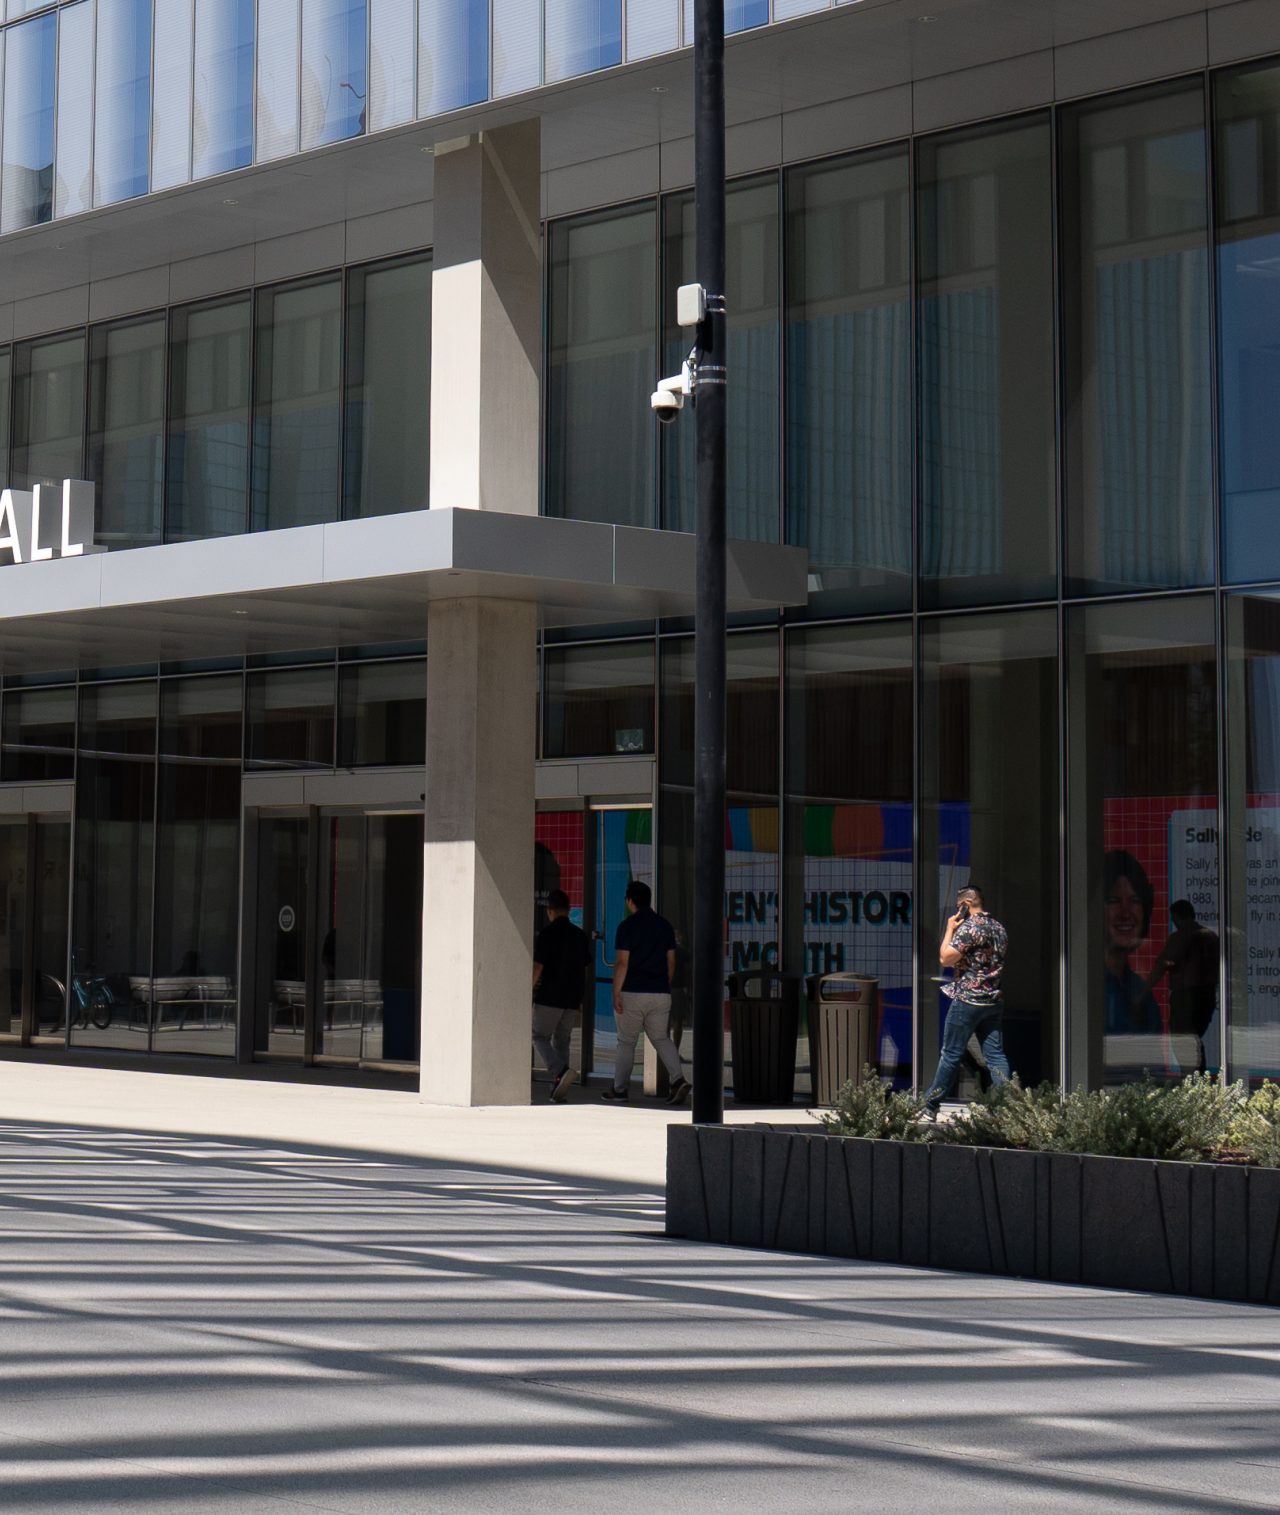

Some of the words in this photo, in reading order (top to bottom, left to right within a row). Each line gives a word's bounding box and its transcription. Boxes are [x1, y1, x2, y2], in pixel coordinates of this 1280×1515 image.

[1185, 857, 1211, 872] Sally
[1264, 859, 1278, 869] an
[1185, 874, 1219, 890] physic
[1260, 874, 1280, 889] join
[803, 890, 912, 924] HISTOR
[732, 941, 845, 973] MOTH
[1249, 946, 1274, 962] Sally
